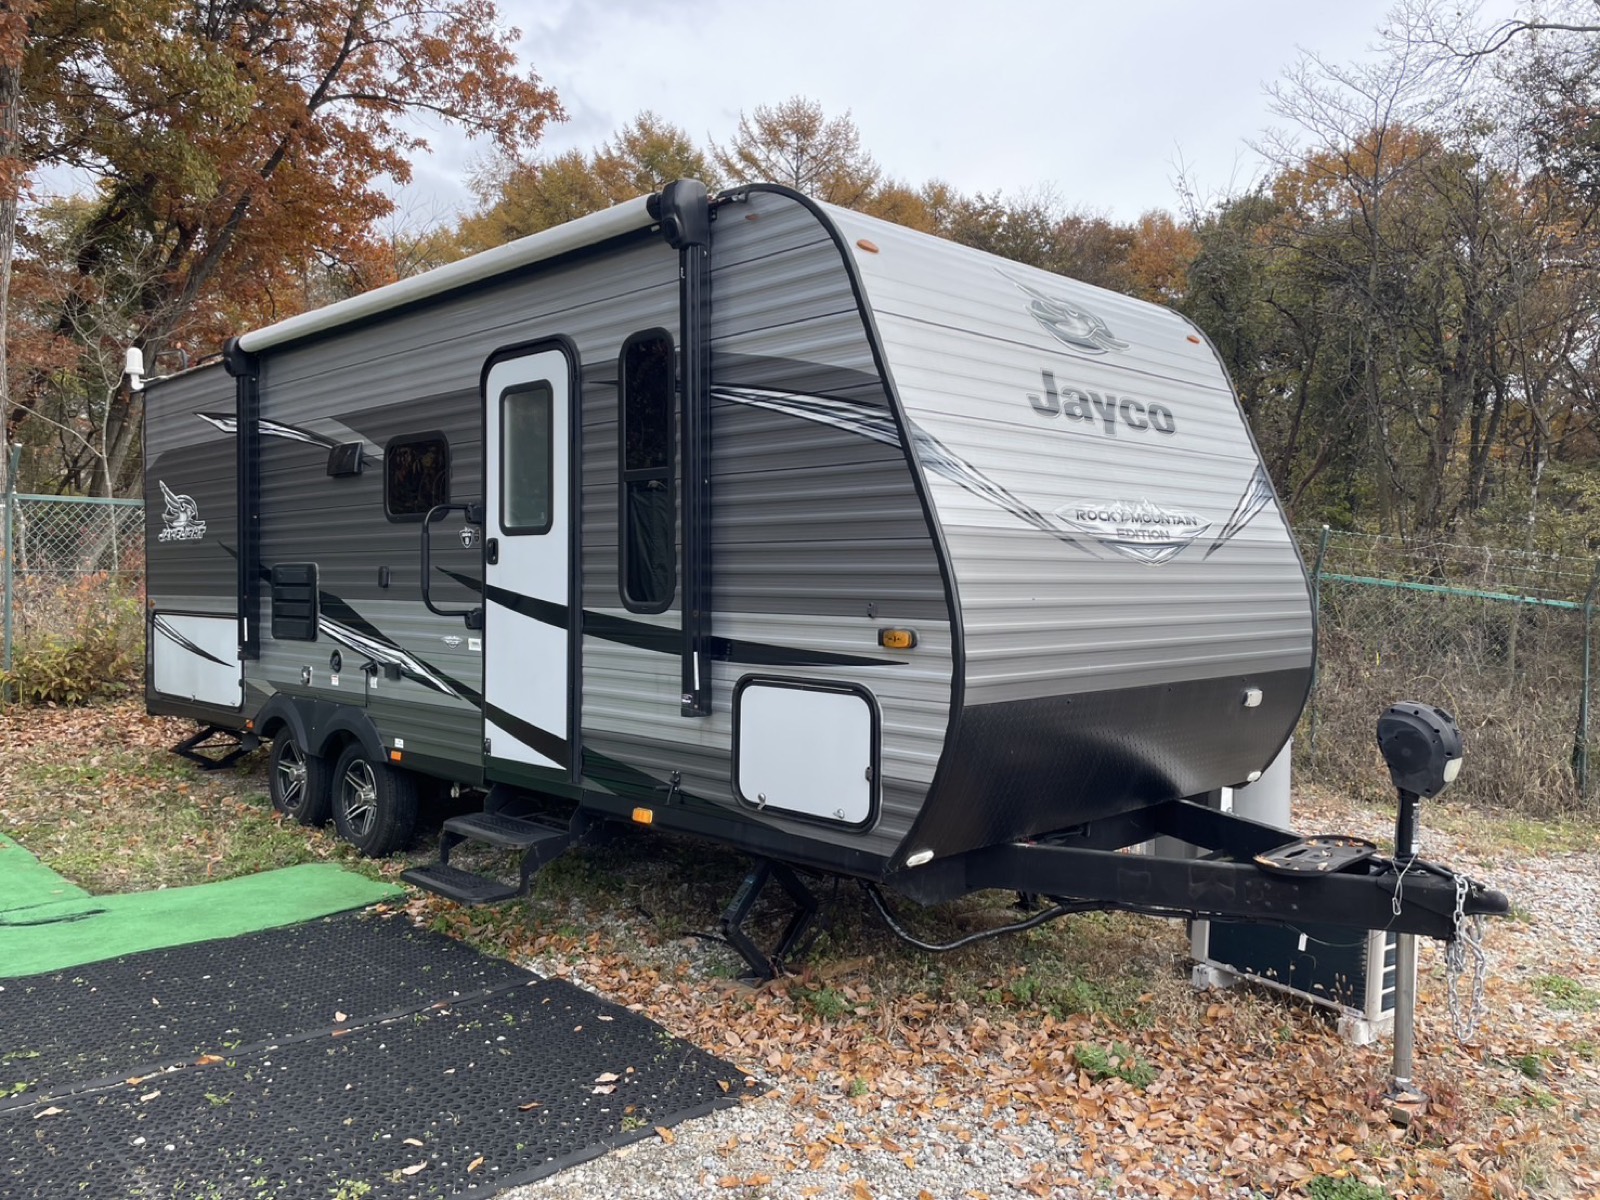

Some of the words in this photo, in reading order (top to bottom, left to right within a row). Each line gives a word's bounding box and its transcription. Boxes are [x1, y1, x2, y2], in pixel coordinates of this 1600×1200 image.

[1027, 368, 1176, 436] Jayco
[1076, 508, 1126, 523] ROCKY
[1131, 513, 1198, 526] MOUNTAIN
[1116, 527, 1171, 540] EDITION
